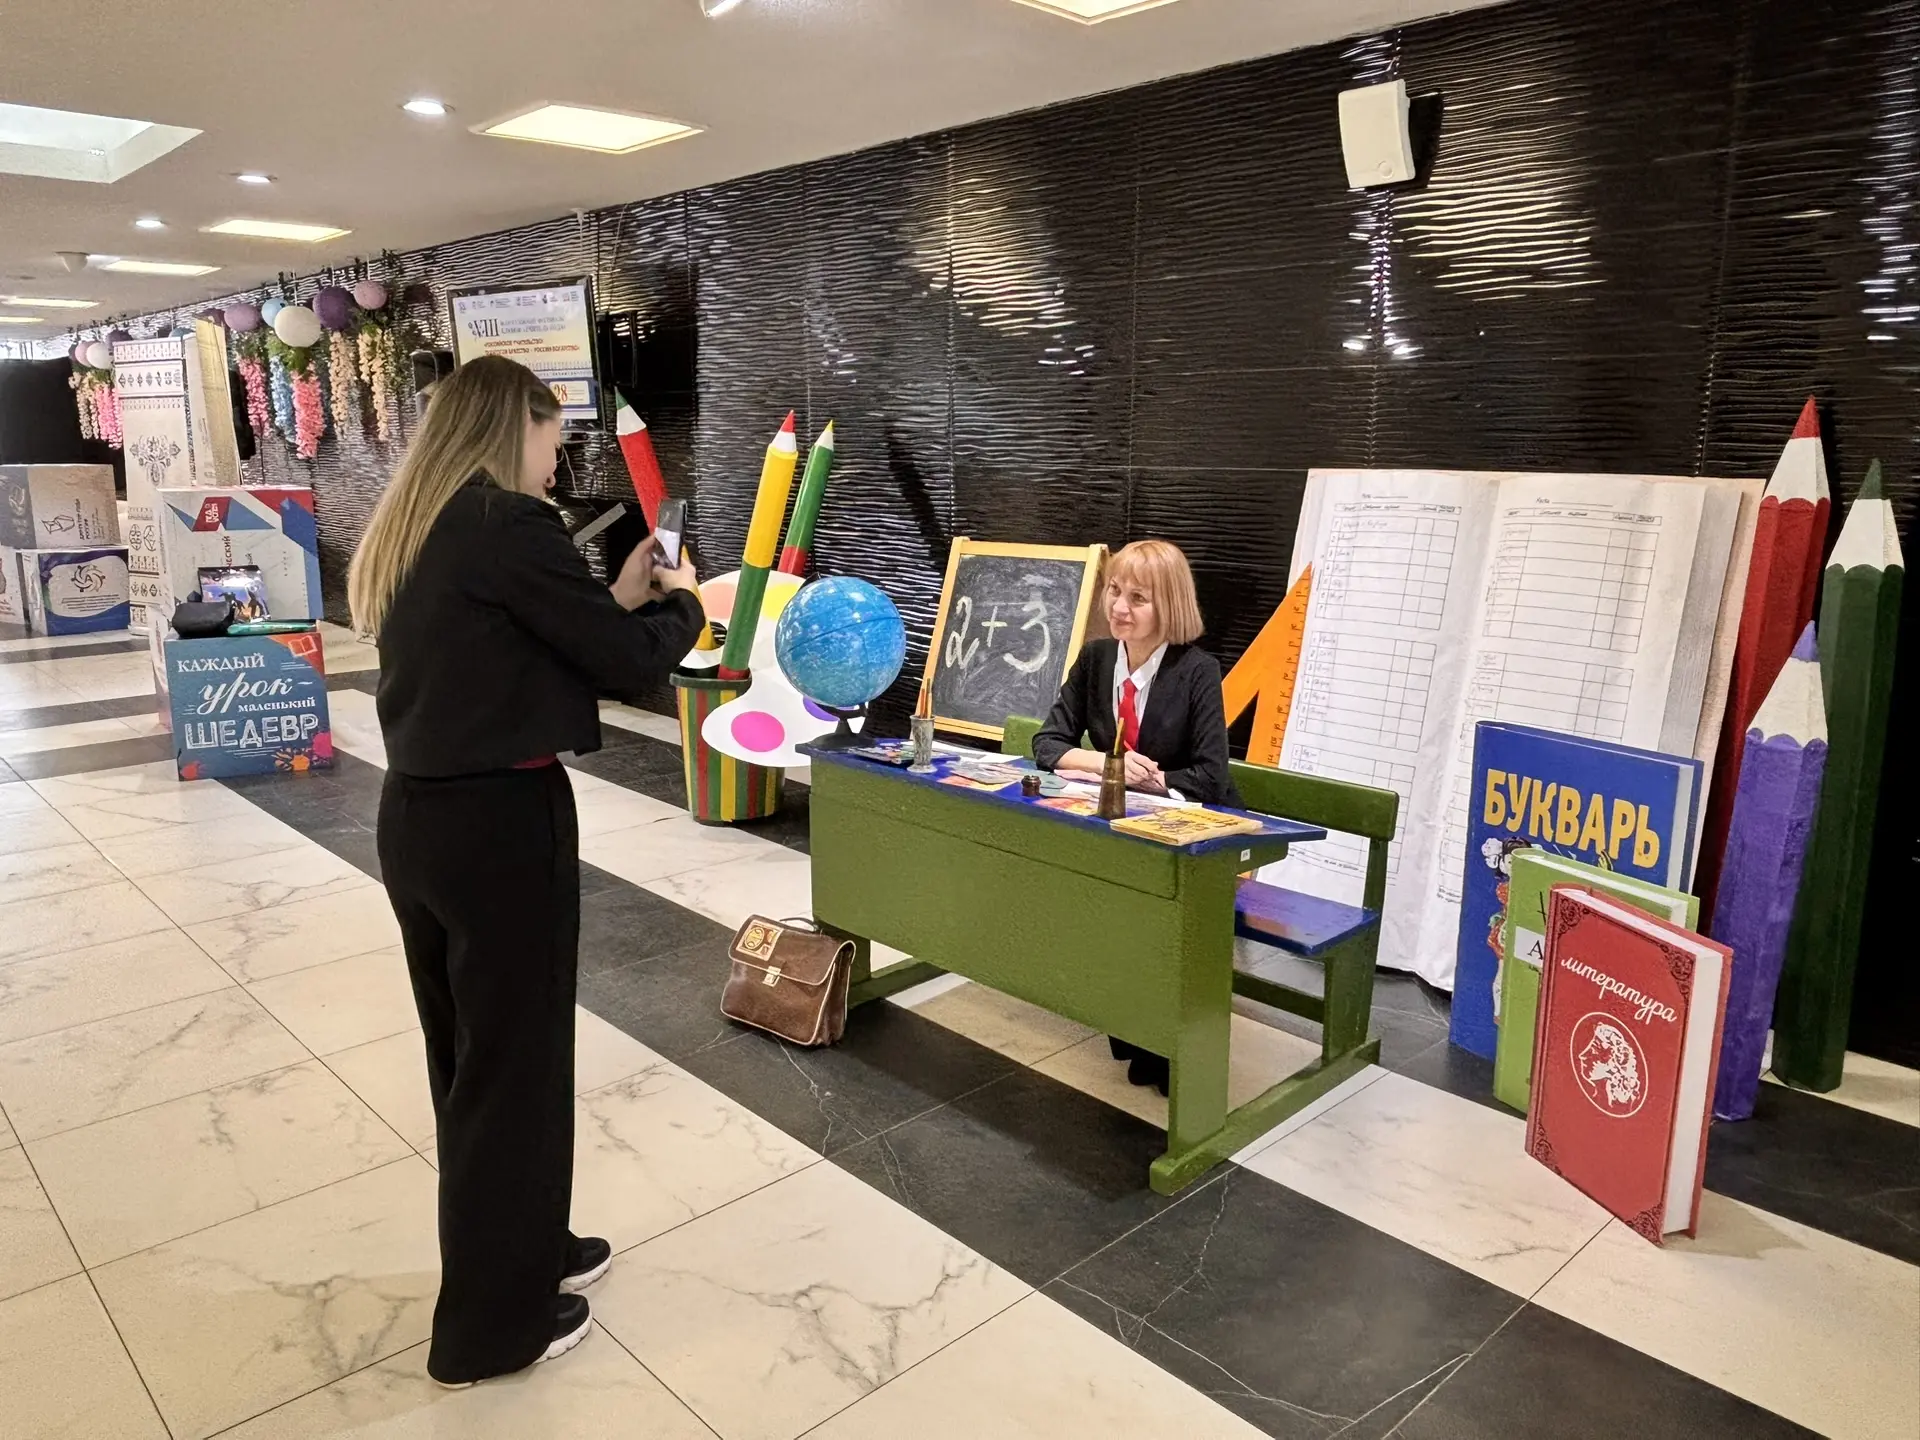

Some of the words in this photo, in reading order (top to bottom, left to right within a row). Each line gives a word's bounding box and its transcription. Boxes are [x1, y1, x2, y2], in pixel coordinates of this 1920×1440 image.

[177, 652, 265, 672] КАЖДЫЙ
[196, 672, 293, 715] урок
[238, 696, 316, 713] маленький
[184, 713, 319, 750] ШЕДЕВР
[1483, 768, 1661, 869] БУКВАРЬ
[1560, 956, 1677, 1023] литература
